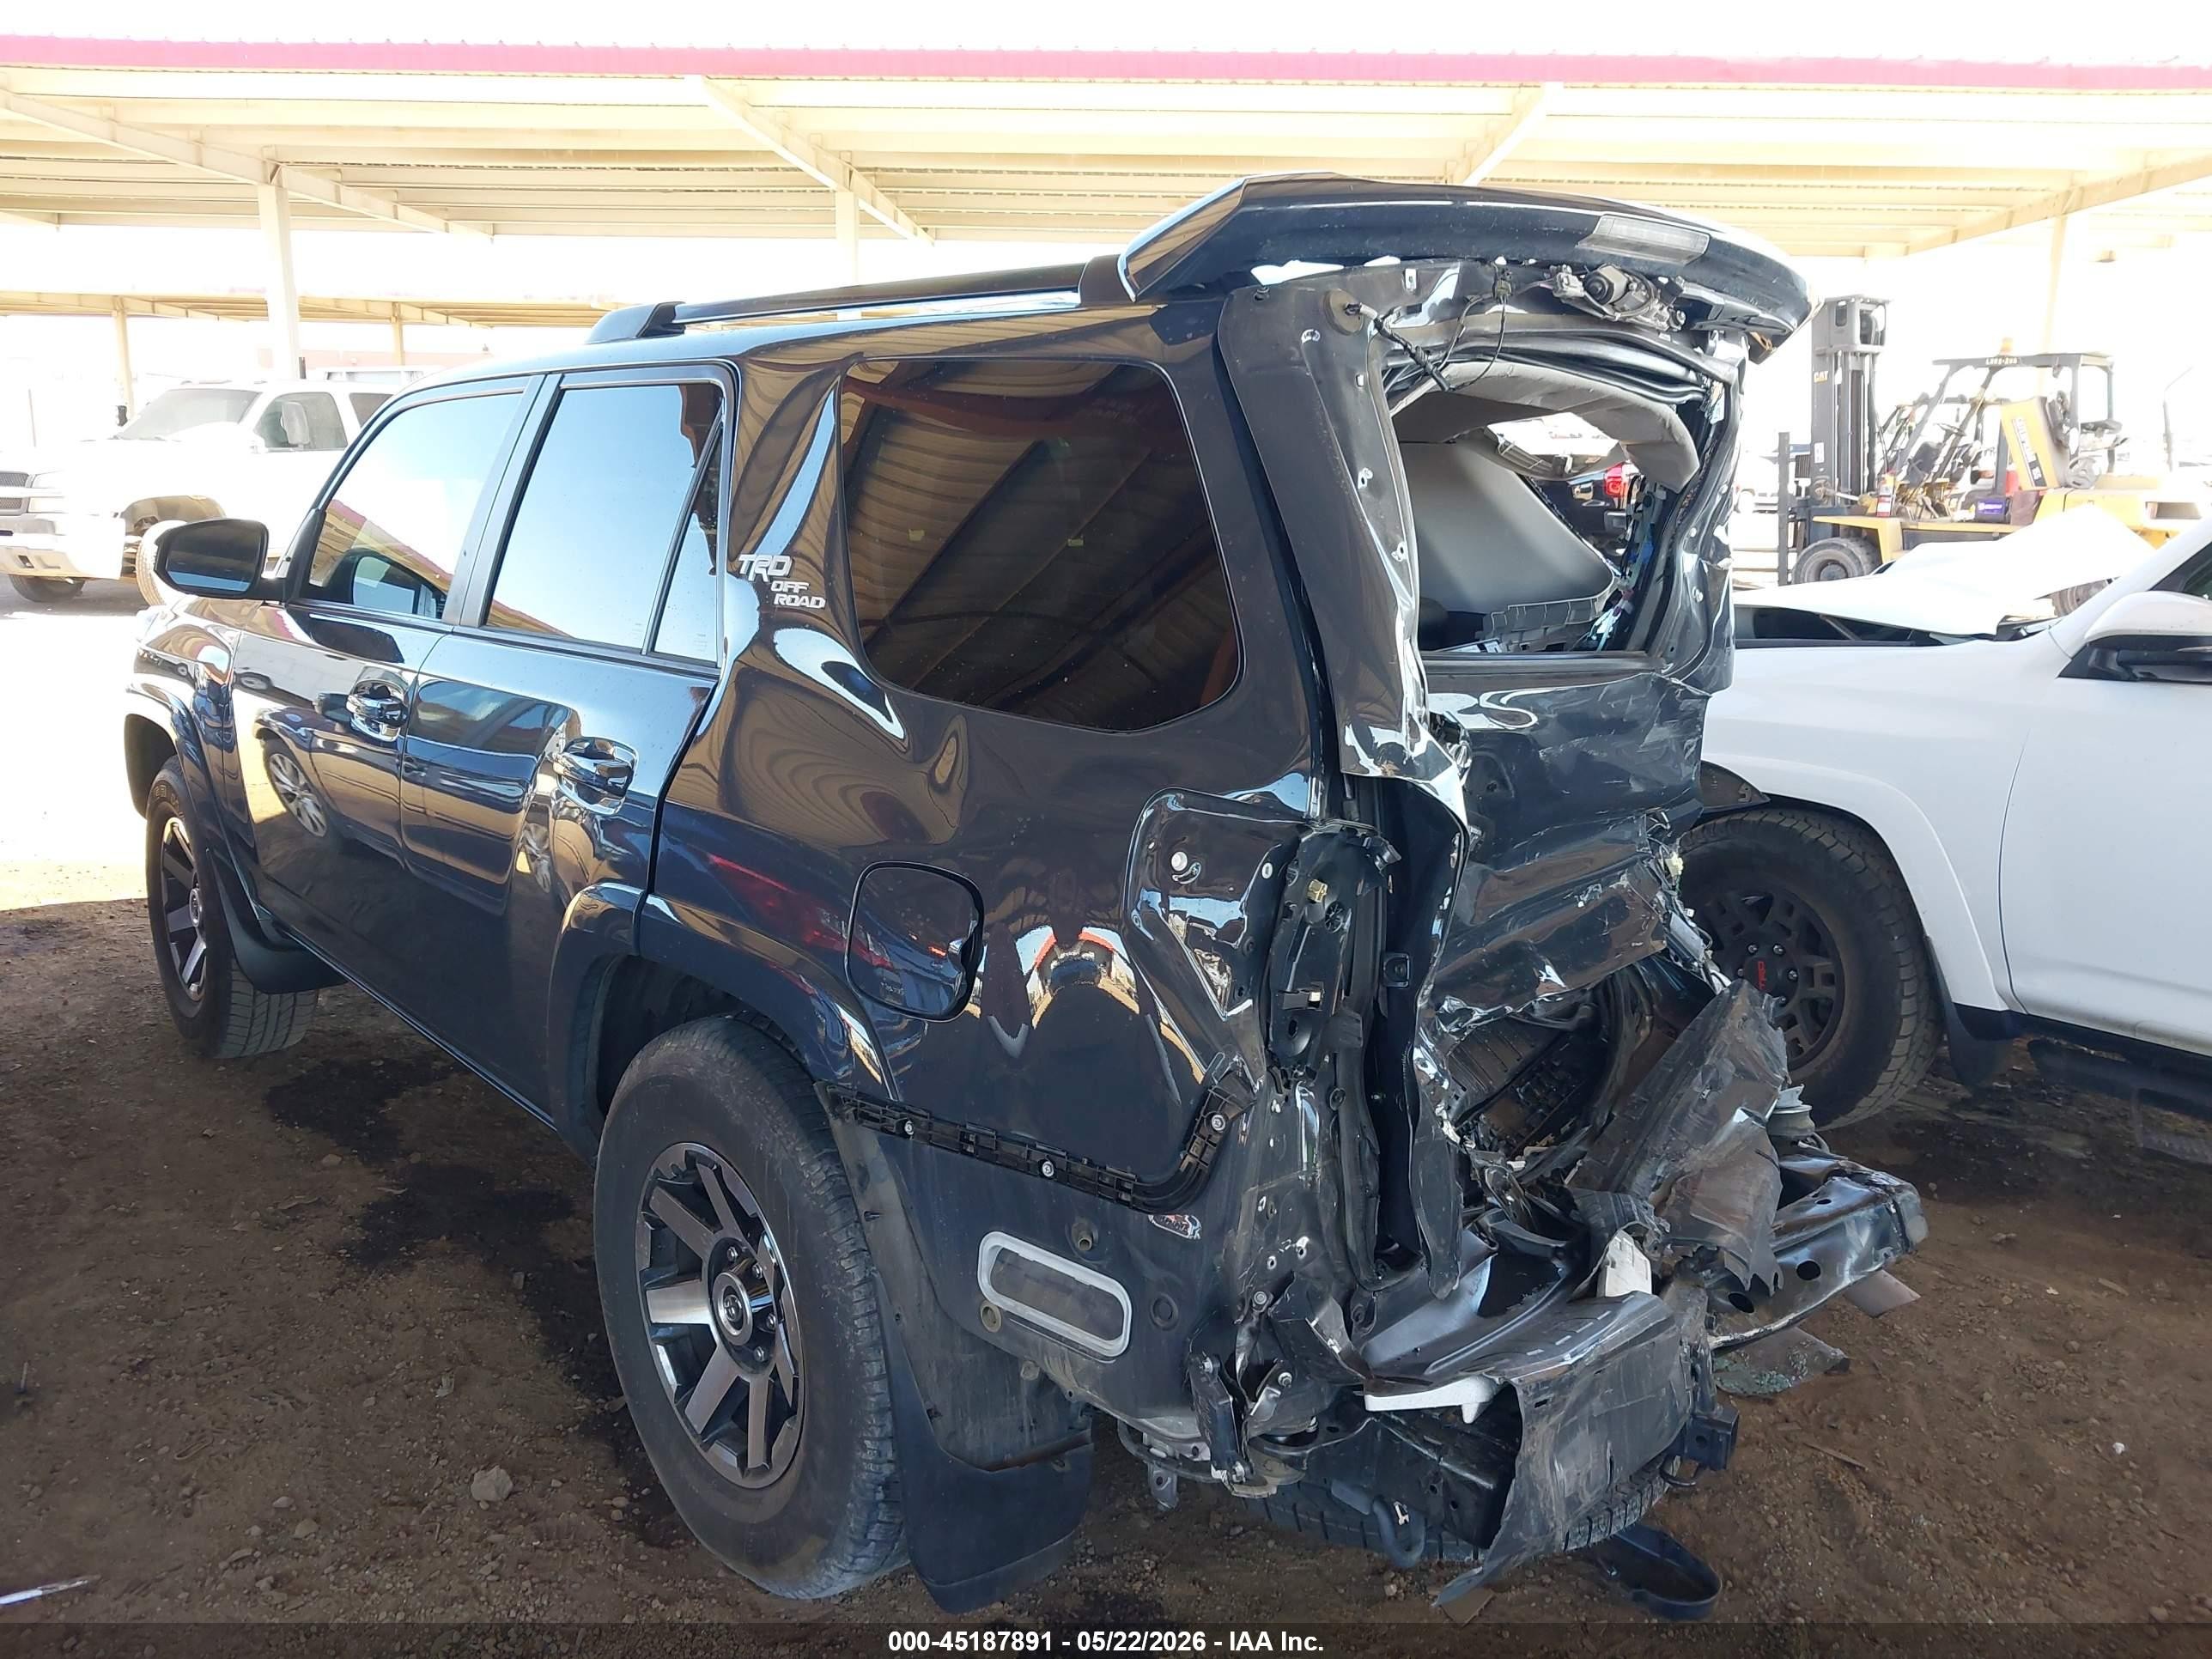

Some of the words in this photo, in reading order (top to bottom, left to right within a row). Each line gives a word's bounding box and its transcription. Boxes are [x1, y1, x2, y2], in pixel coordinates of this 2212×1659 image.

[738, 554, 793, 582] TRD
[770, 580, 809, 593] OFF
[774, 593, 826, 609] ROAD
